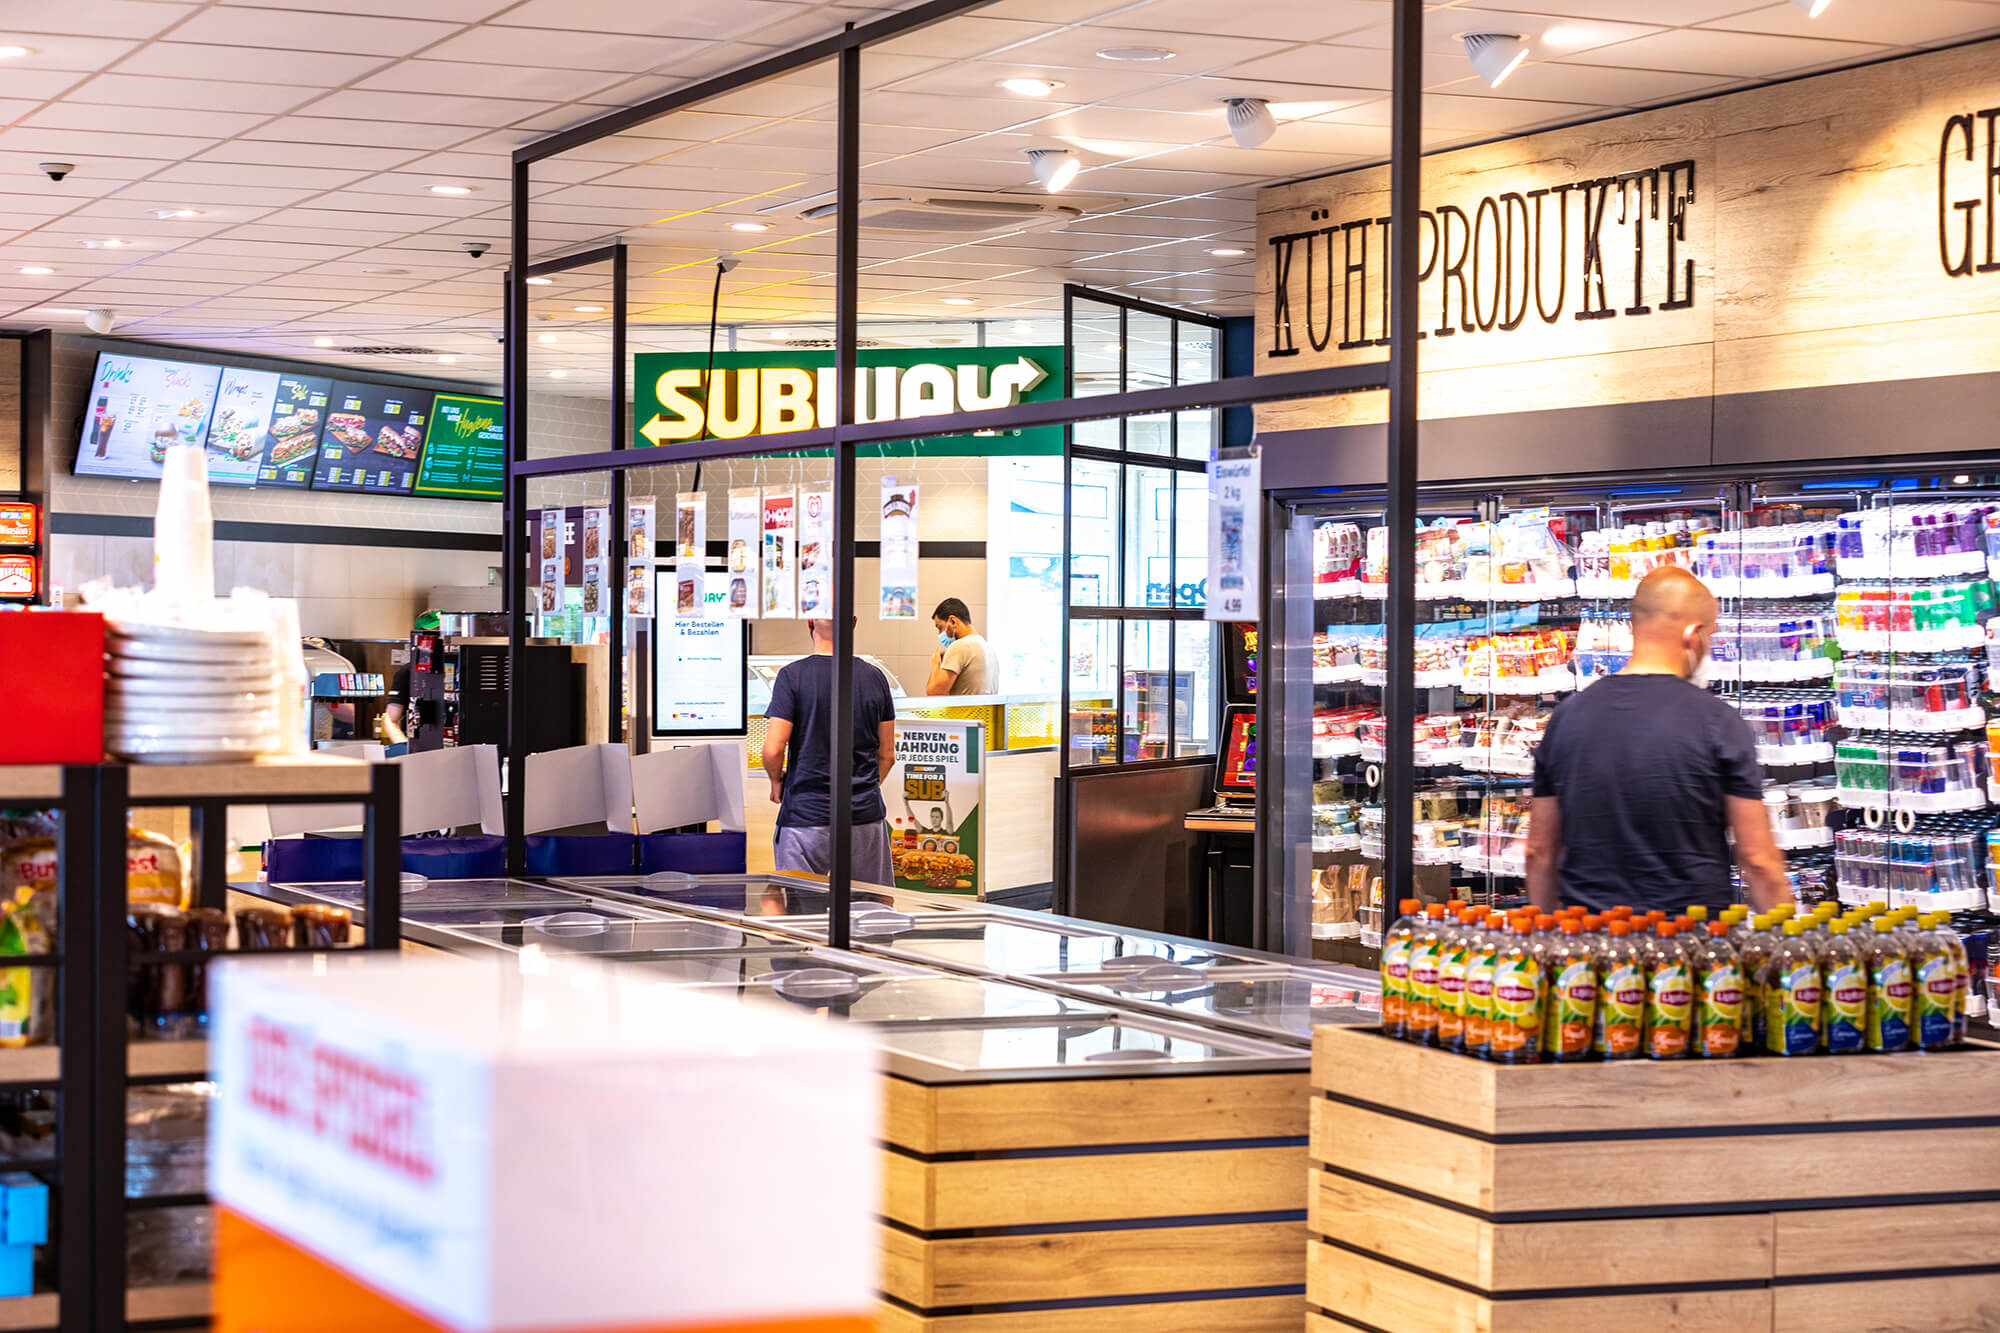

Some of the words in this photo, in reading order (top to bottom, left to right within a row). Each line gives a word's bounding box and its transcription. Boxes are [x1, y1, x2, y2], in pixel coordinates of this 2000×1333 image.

[639, 356, 1049, 447] SUBWAY
[903, 732, 946, 741] NERVEN
[908, 754, 934, 762] JEDES
[935, 755, 959, 763] SPIEL
[905, 780, 945, 800] SUB
